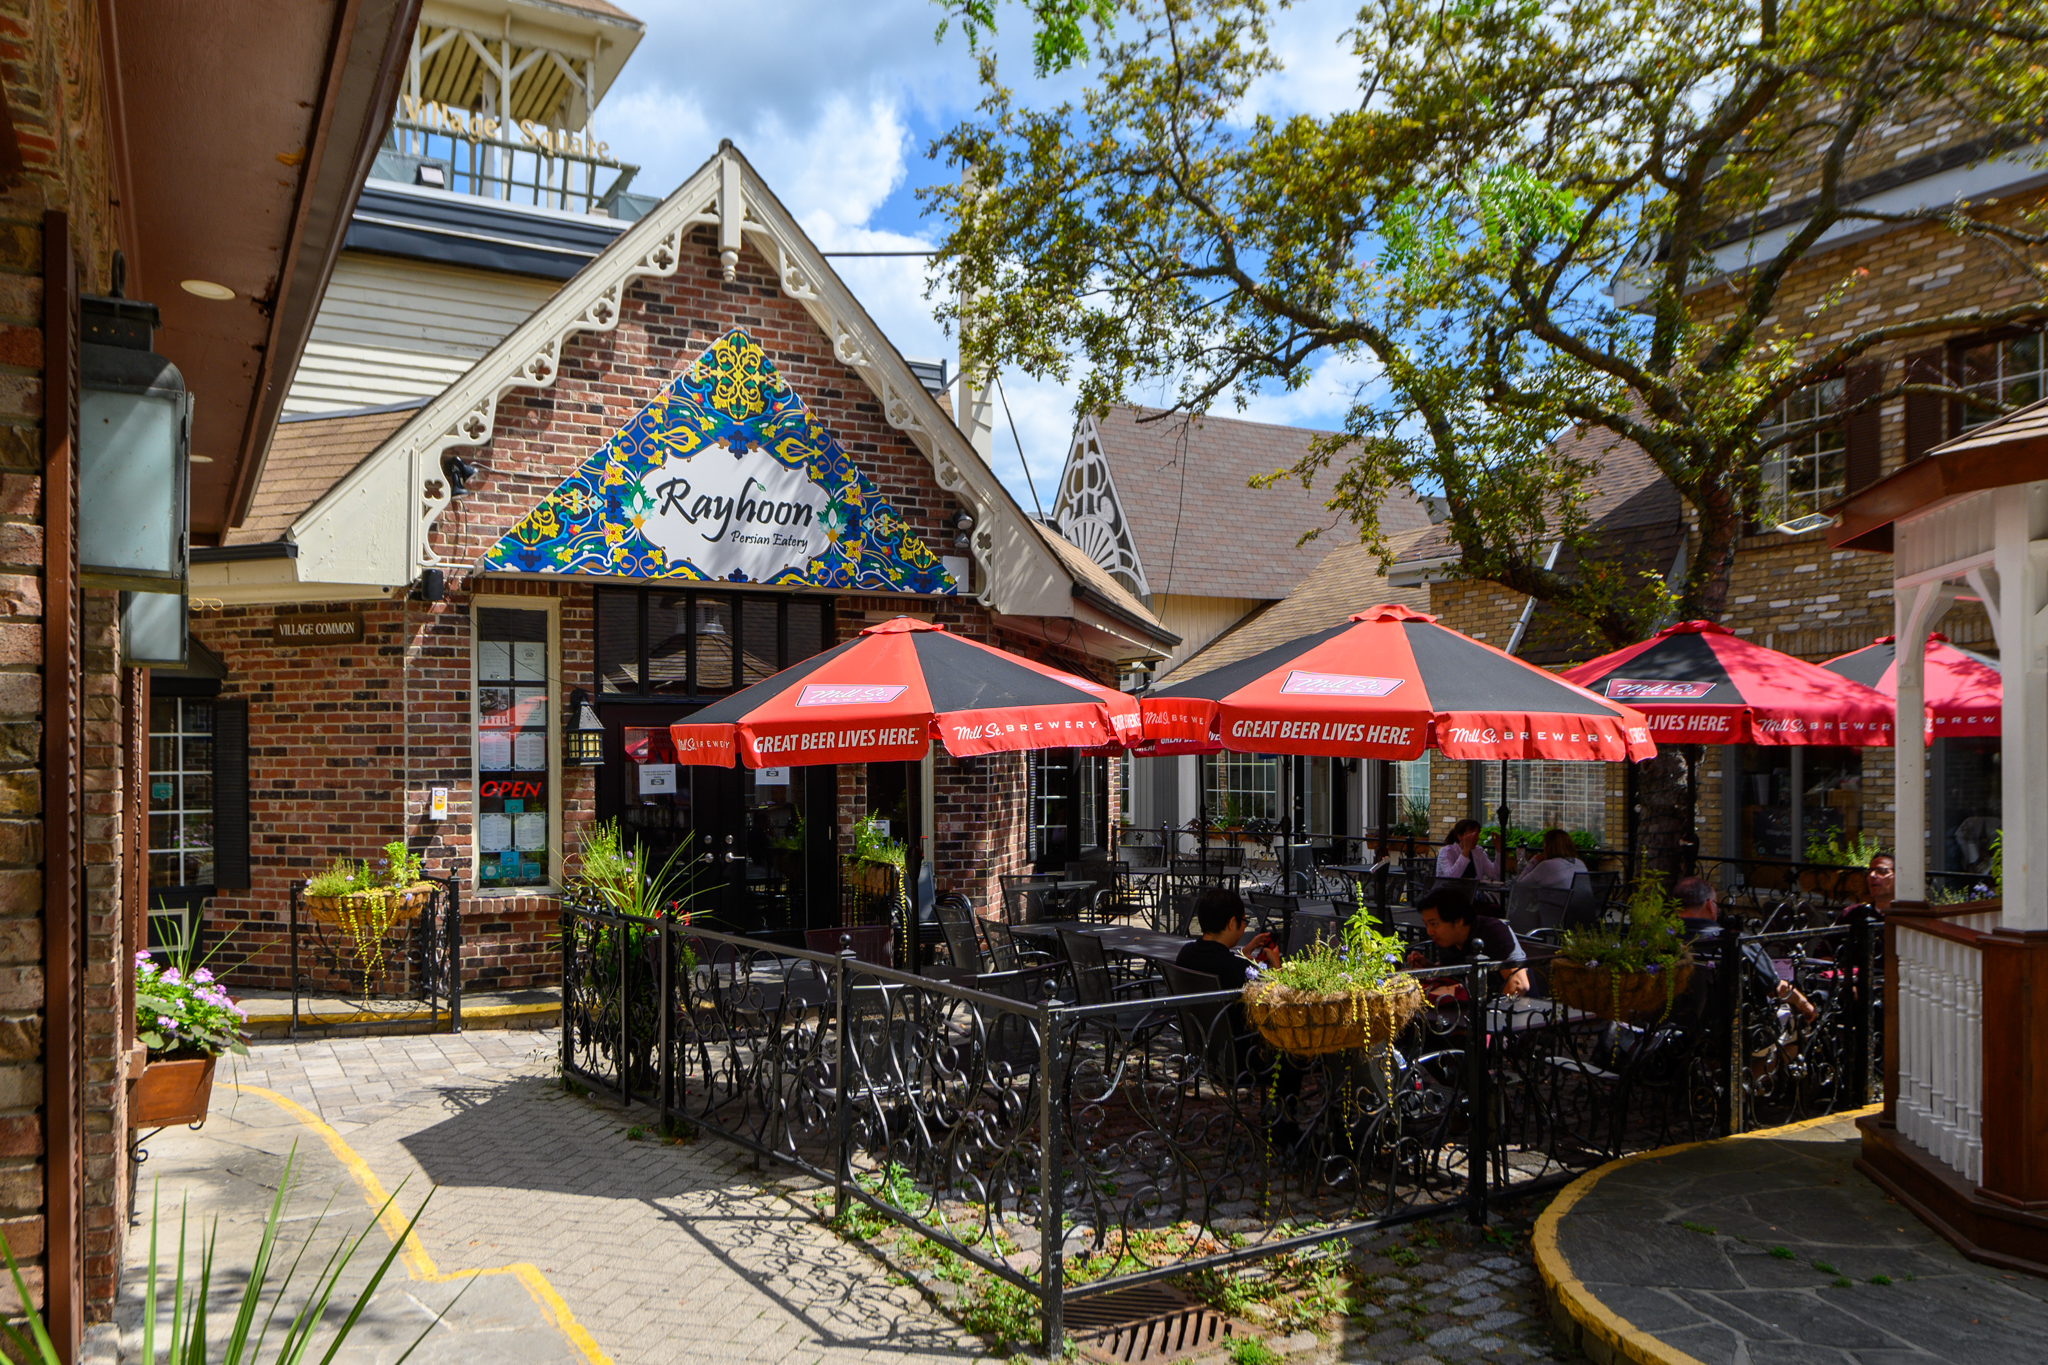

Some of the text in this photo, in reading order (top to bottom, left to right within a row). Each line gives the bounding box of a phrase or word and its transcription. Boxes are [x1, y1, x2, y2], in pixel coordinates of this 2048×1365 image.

[403, 94, 498, 144] Village
[655, 476, 813, 543] Rayhoon
[731, 530, 808, 554] Persian Eatery
[279, 622, 355, 636] VILLAGE COMMON
[1647, 715, 1685, 730] LIVES
[1758, 718, 1790, 733] Mill
[1809, 721, 1892, 731] BREWER
[1936, 716, 1996, 725] BREW
[952, 724, 983, 741] Mill
[984, 722, 1005, 739] St.
[1005, 720, 1098, 733] BREWERY
[1232, 720, 1280, 738] GREAT
[1280, 722, 1321, 740] BEER
[1322, 722, 1364, 742] LIVES
[1448, 727, 1480, 744] Mill
[1480, 727, 1501, 744] St.
[1503, 731, 1613, 743] BREWERY
[753, 734, 799, 753] GREAT
[800, 731, 838, 750] BEER
[838, 728, 877, 748] LIVES
[480, 780, 542, 798] OPEN
